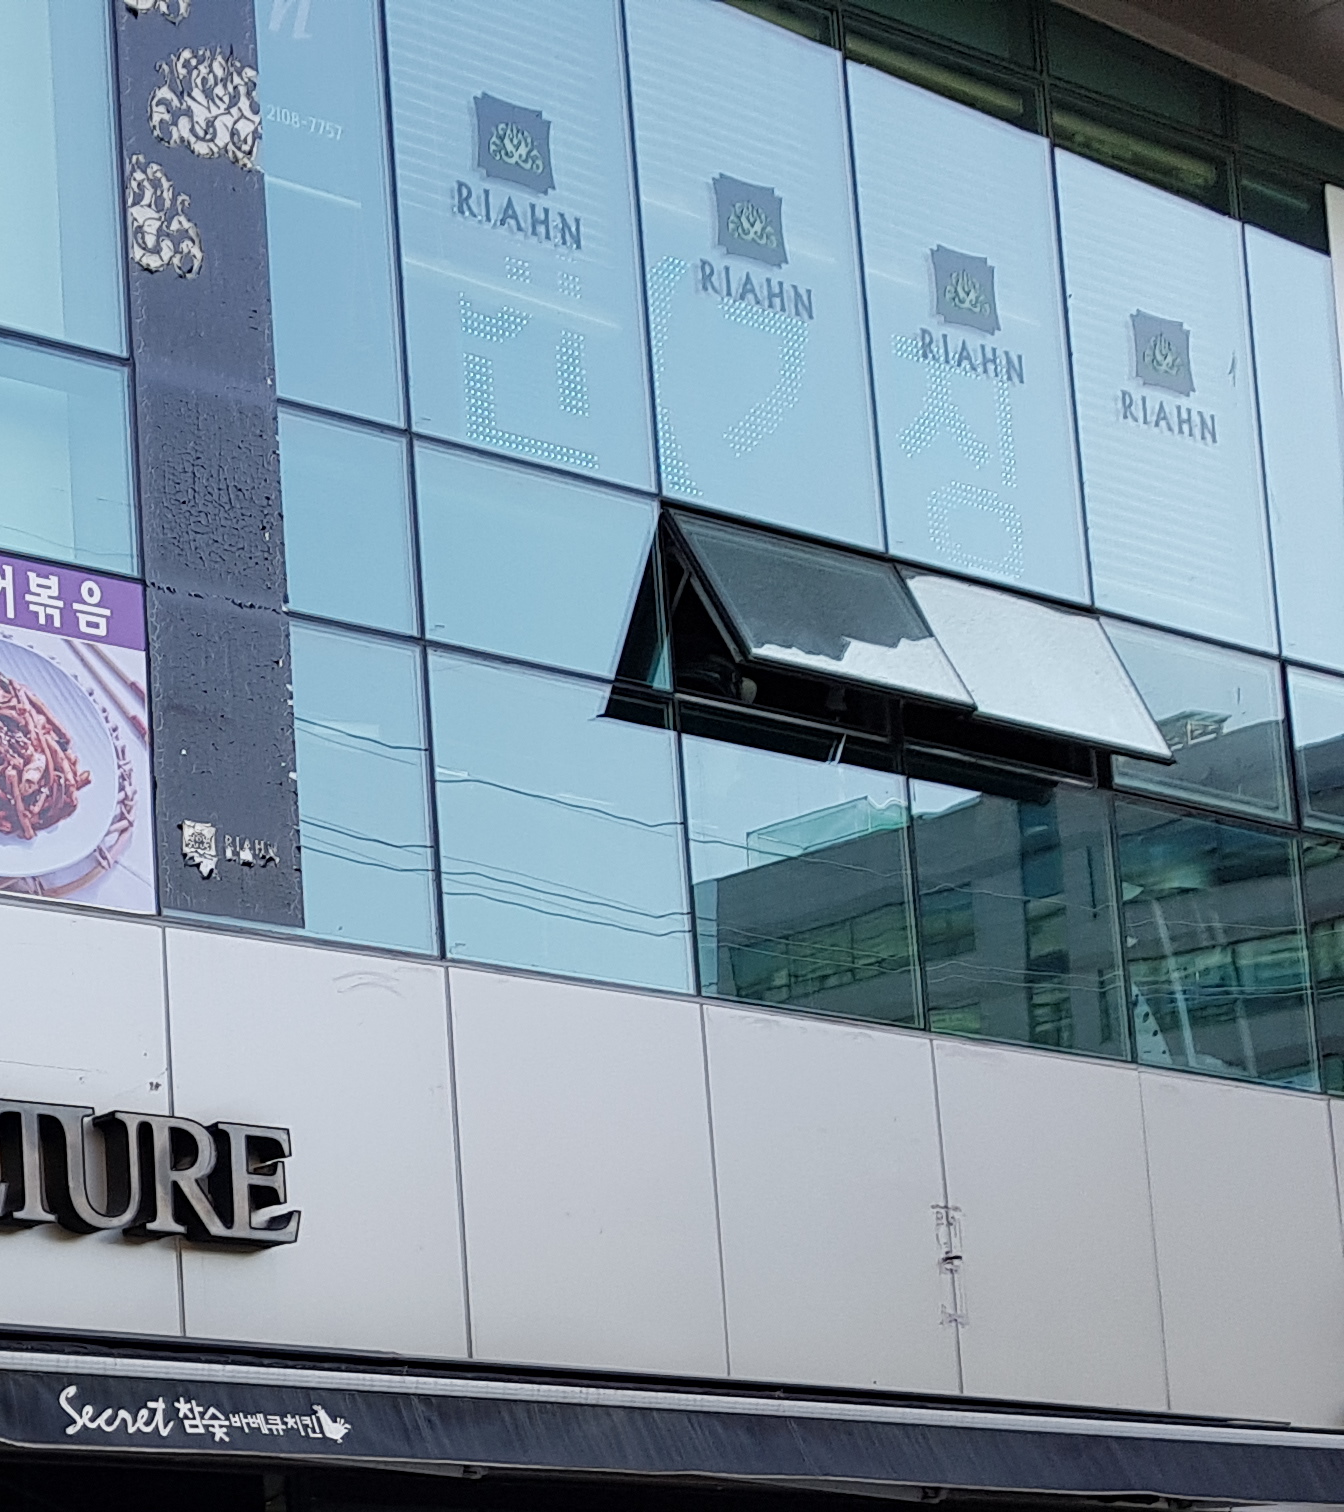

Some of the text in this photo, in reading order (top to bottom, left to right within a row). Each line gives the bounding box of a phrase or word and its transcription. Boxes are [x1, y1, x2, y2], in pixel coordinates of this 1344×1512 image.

[454, 180, 584, 251] RIAHN
[699, 259, 815, 320] RIAHN
[919, 328, 1025, 384] RIAHN
[1120, 389, 1218, 444] RIAHN
[58, 1385, 175, 1437] Secret
